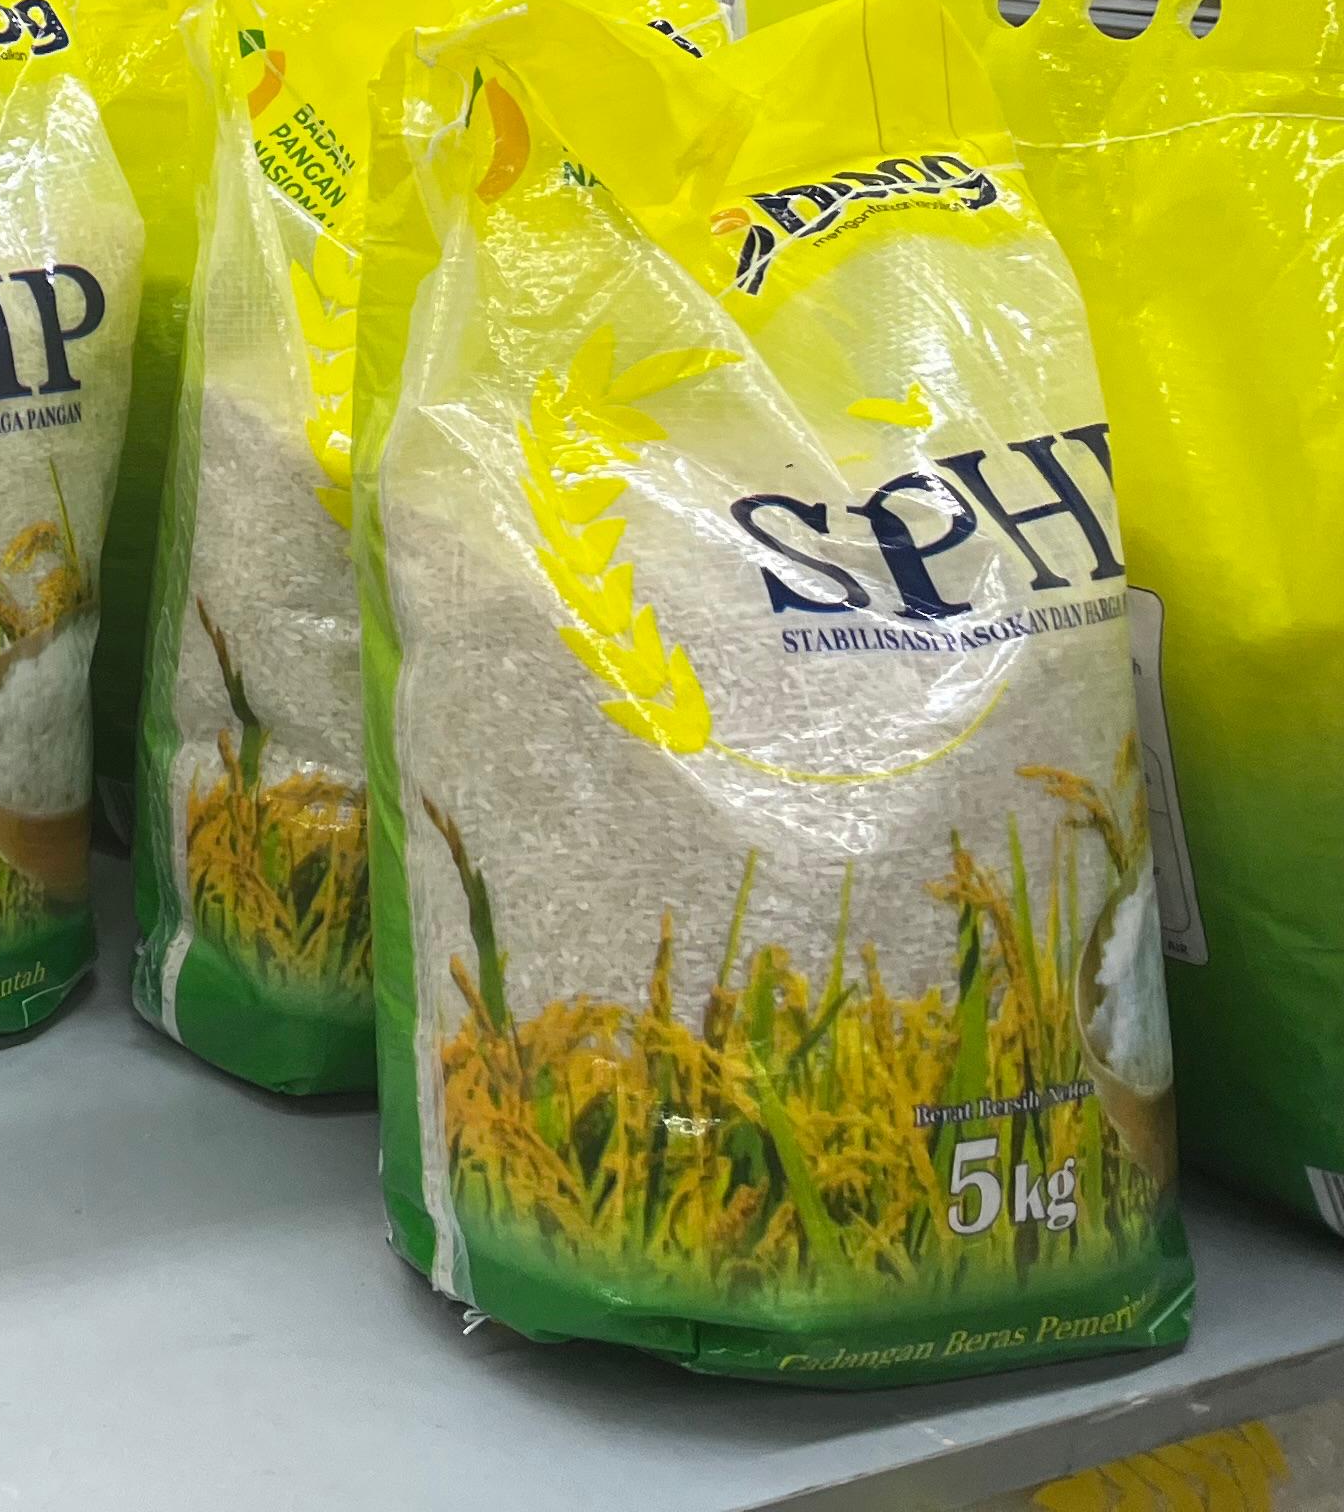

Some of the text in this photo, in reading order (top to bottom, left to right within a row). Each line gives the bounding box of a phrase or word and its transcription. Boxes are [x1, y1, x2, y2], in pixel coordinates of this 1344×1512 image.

[269, 123, 347, 208] PANGAN
[27, 401, 83, 430] PANGAN
[781, 626, 942, 654] STABILISASI
[944, 610, 1050, 653] PASOKAN
[1051, 605, 1083, 631] DAN
[912, 1101, 972, 1128] Berat
[1013, 1156, 1078, 1232] kg
[941, 1329, 1028, 1358] Beras
